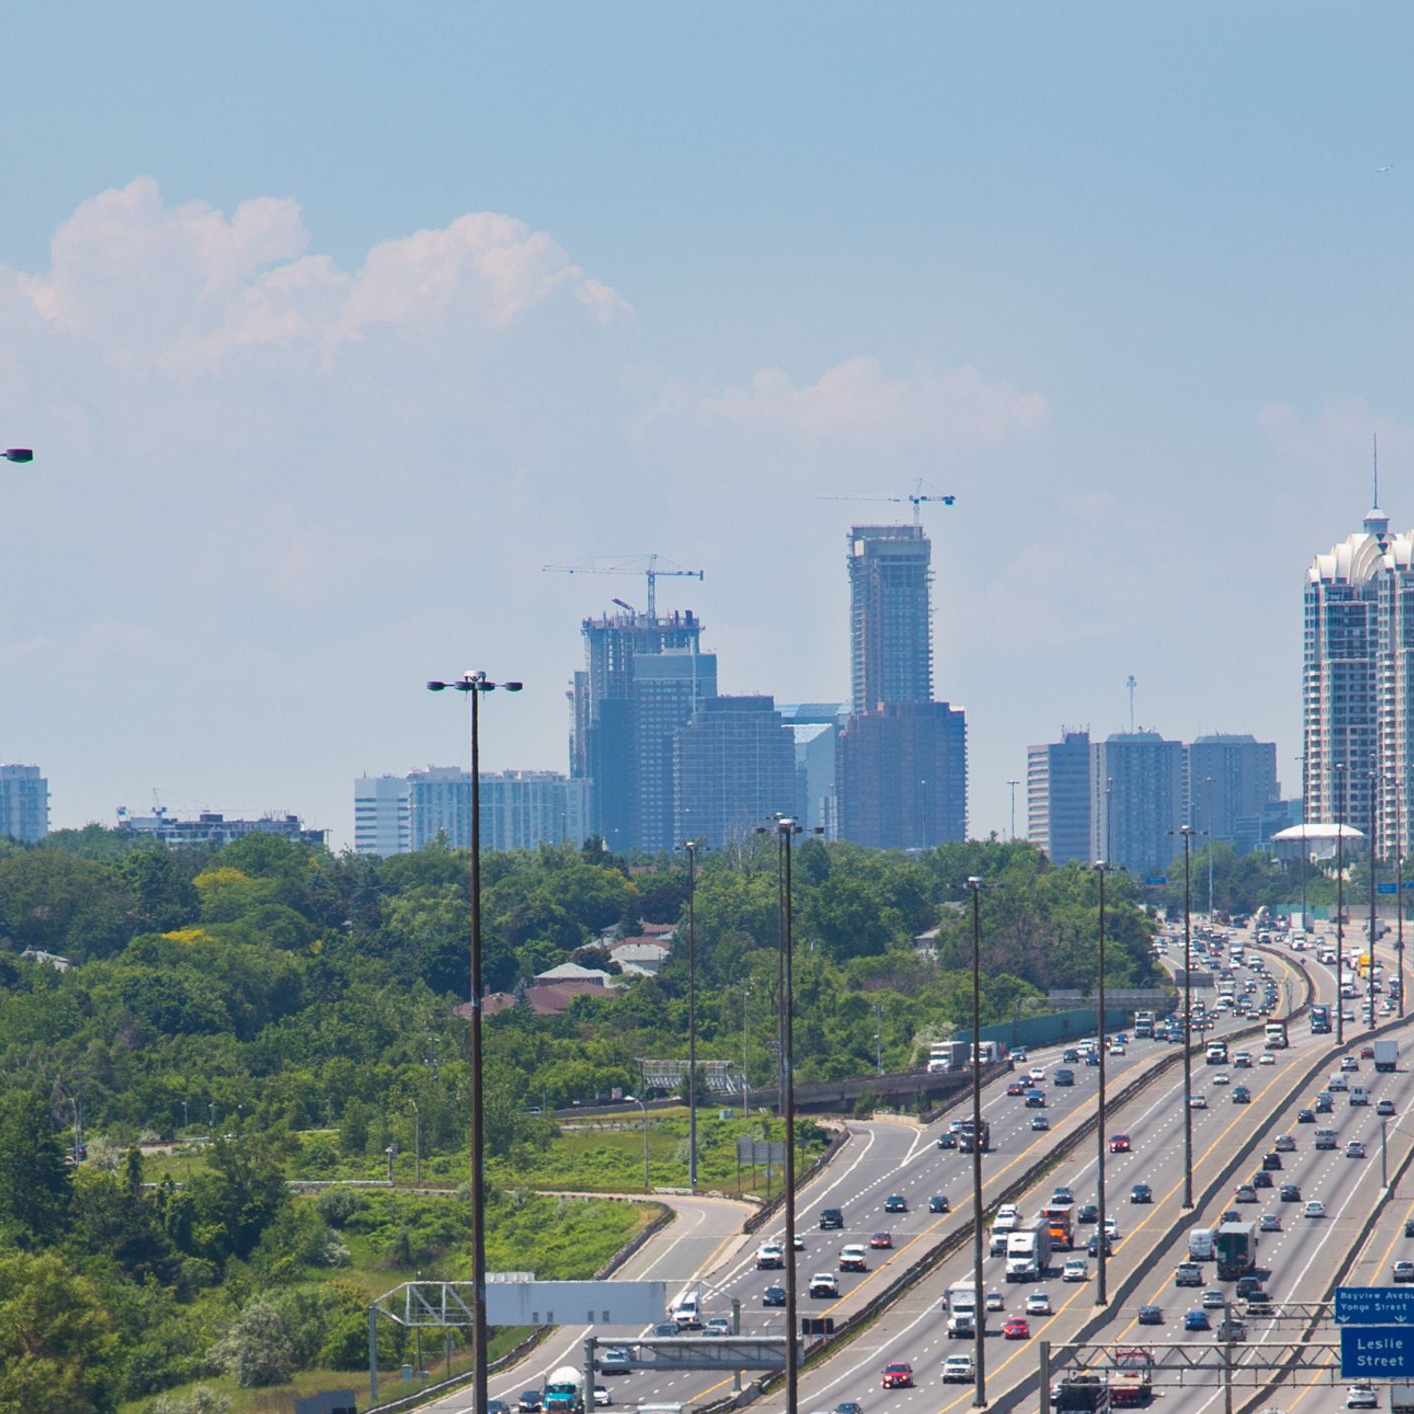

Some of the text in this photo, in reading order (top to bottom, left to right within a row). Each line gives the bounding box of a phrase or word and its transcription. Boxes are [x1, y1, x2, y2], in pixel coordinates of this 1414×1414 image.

[1340, 1292, 1381, 1301] Bayview
[1341, 1303, 1407, 1312] Yonge Street
[1357, 1338, 1403, 1350] Leslie
[1357, 1355, 1404, 1366] Street
